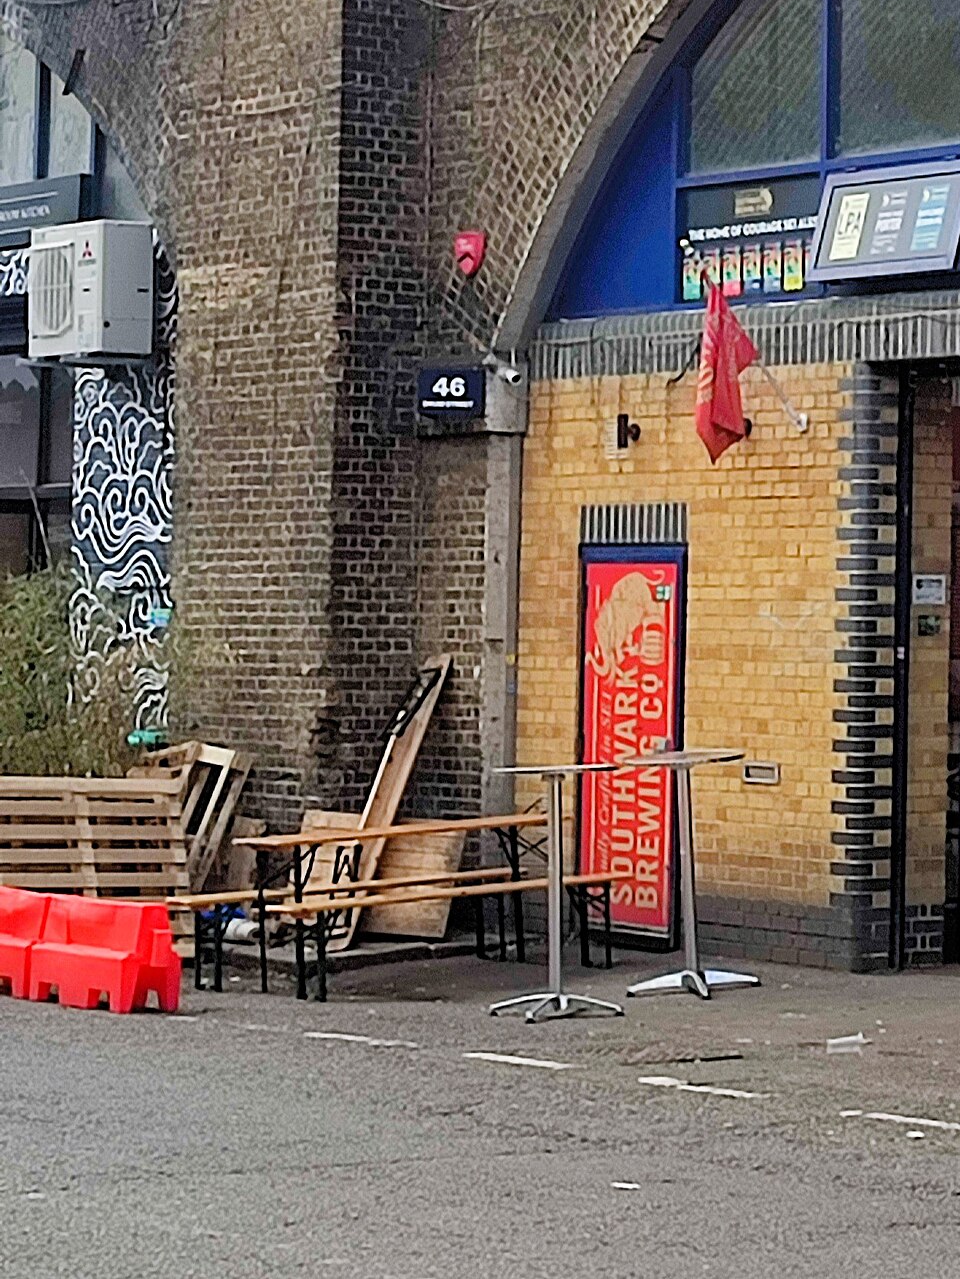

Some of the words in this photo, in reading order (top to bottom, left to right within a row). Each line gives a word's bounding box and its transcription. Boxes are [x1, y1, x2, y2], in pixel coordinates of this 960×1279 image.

[705, 225, 730, 239] HOME
[730, 224, 742, 237] OF
[743, 220, 782, 236] COURAGE
[432, 376, 466, 398] 46
[609, 664, 639, 907] SOUTHWARK
[634, 734, 667, 910] BREWING
